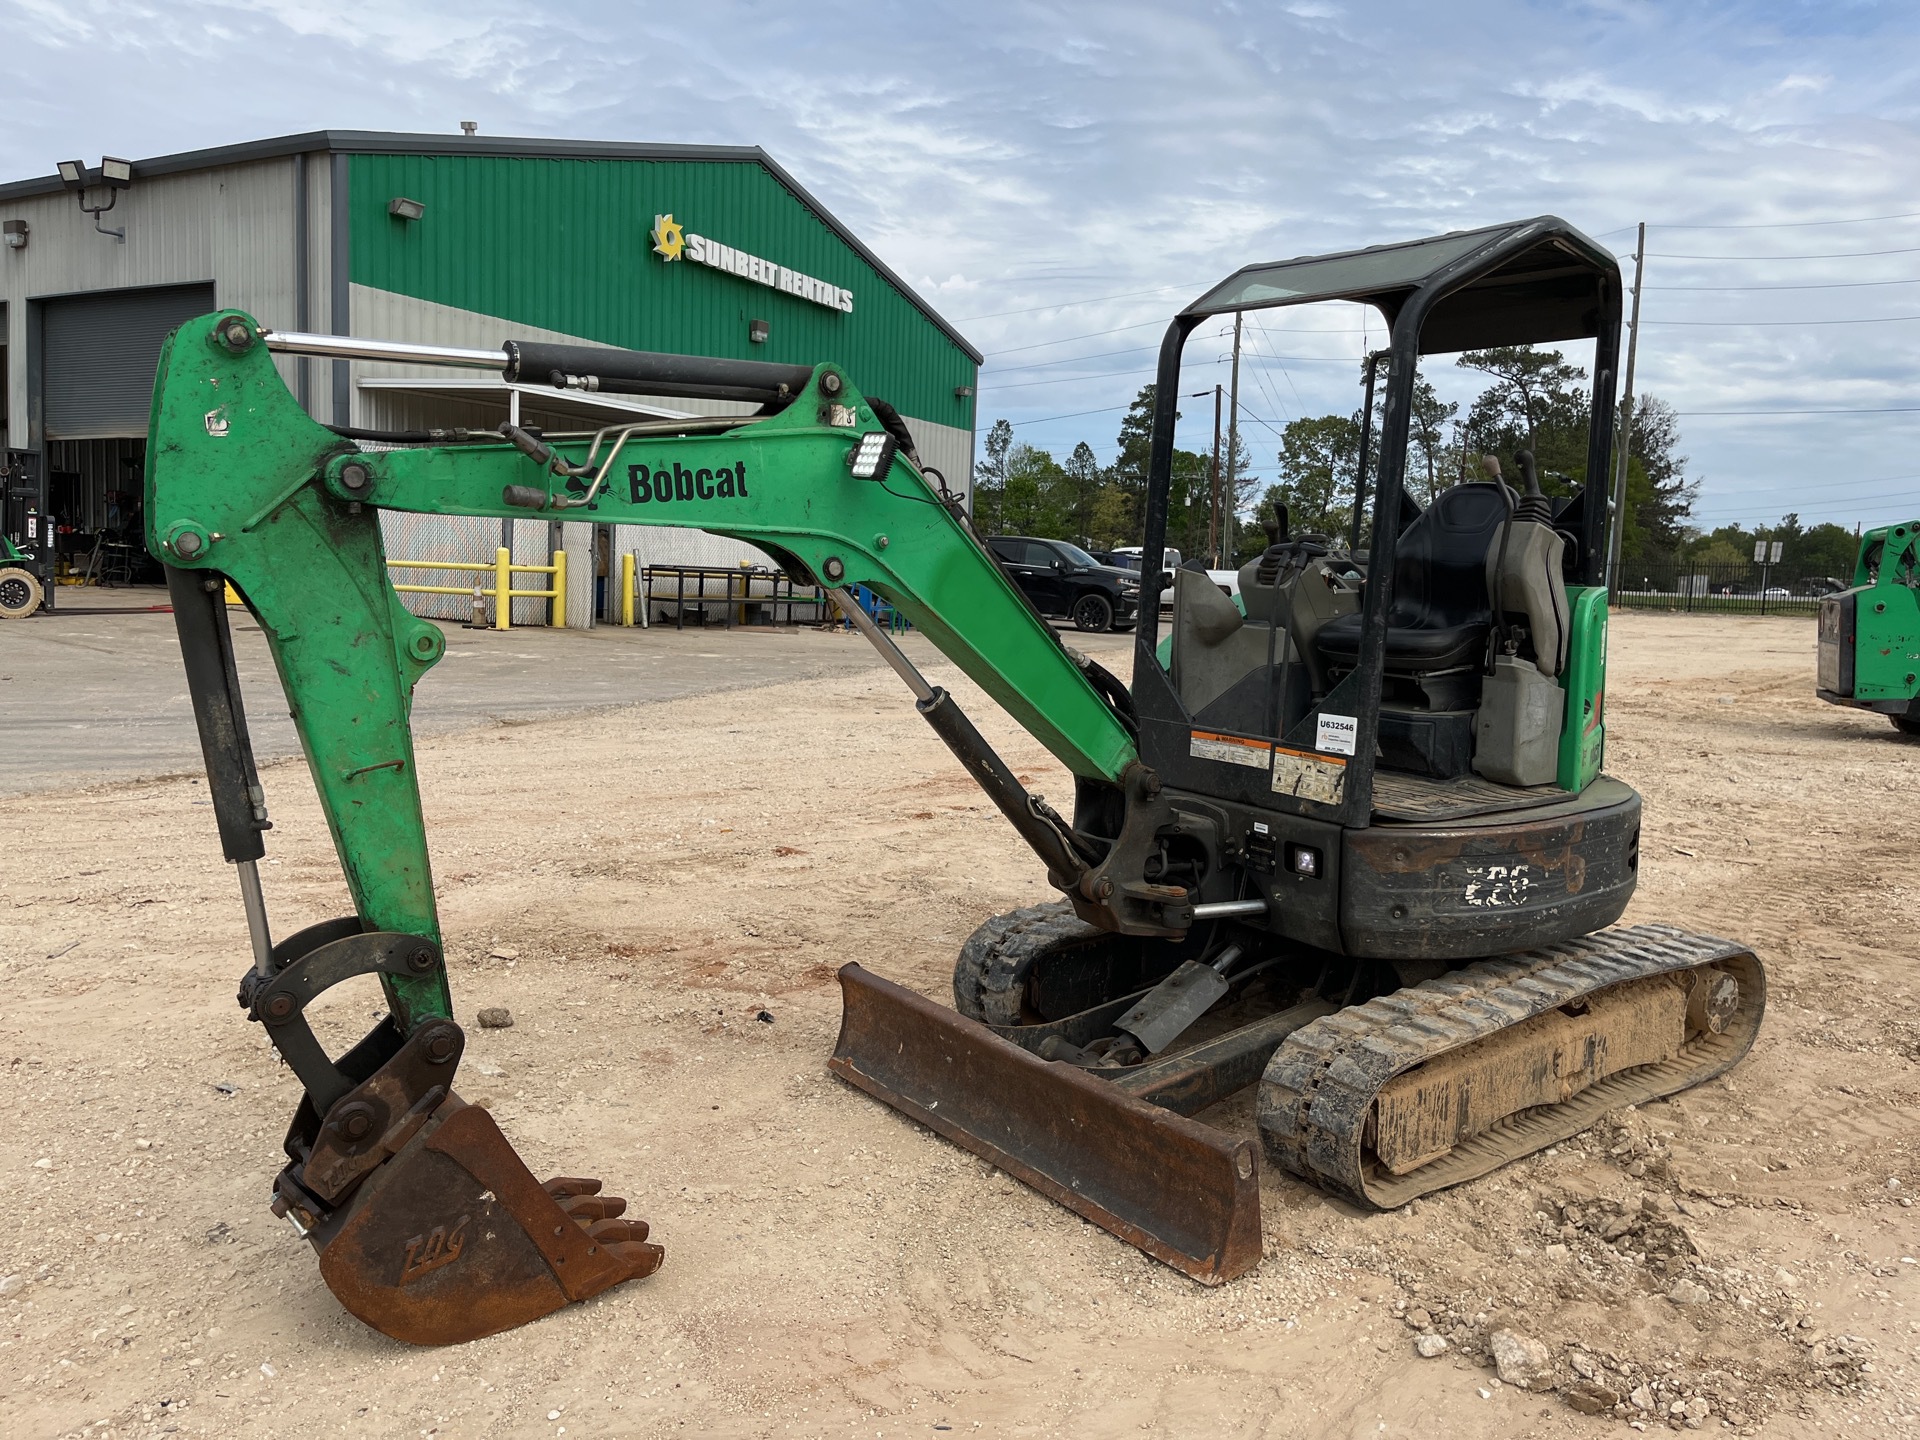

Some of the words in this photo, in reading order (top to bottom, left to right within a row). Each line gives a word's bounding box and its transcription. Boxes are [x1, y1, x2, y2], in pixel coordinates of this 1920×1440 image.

[686, 233, 777, 287] SUNBELT
[777, 266, 853, 313] RENTALS
[628, 461, 748, 504] Bobcat
[1320, 720, 1354, 732] U632546
[1221, 736, 1245, 745] WARNING
